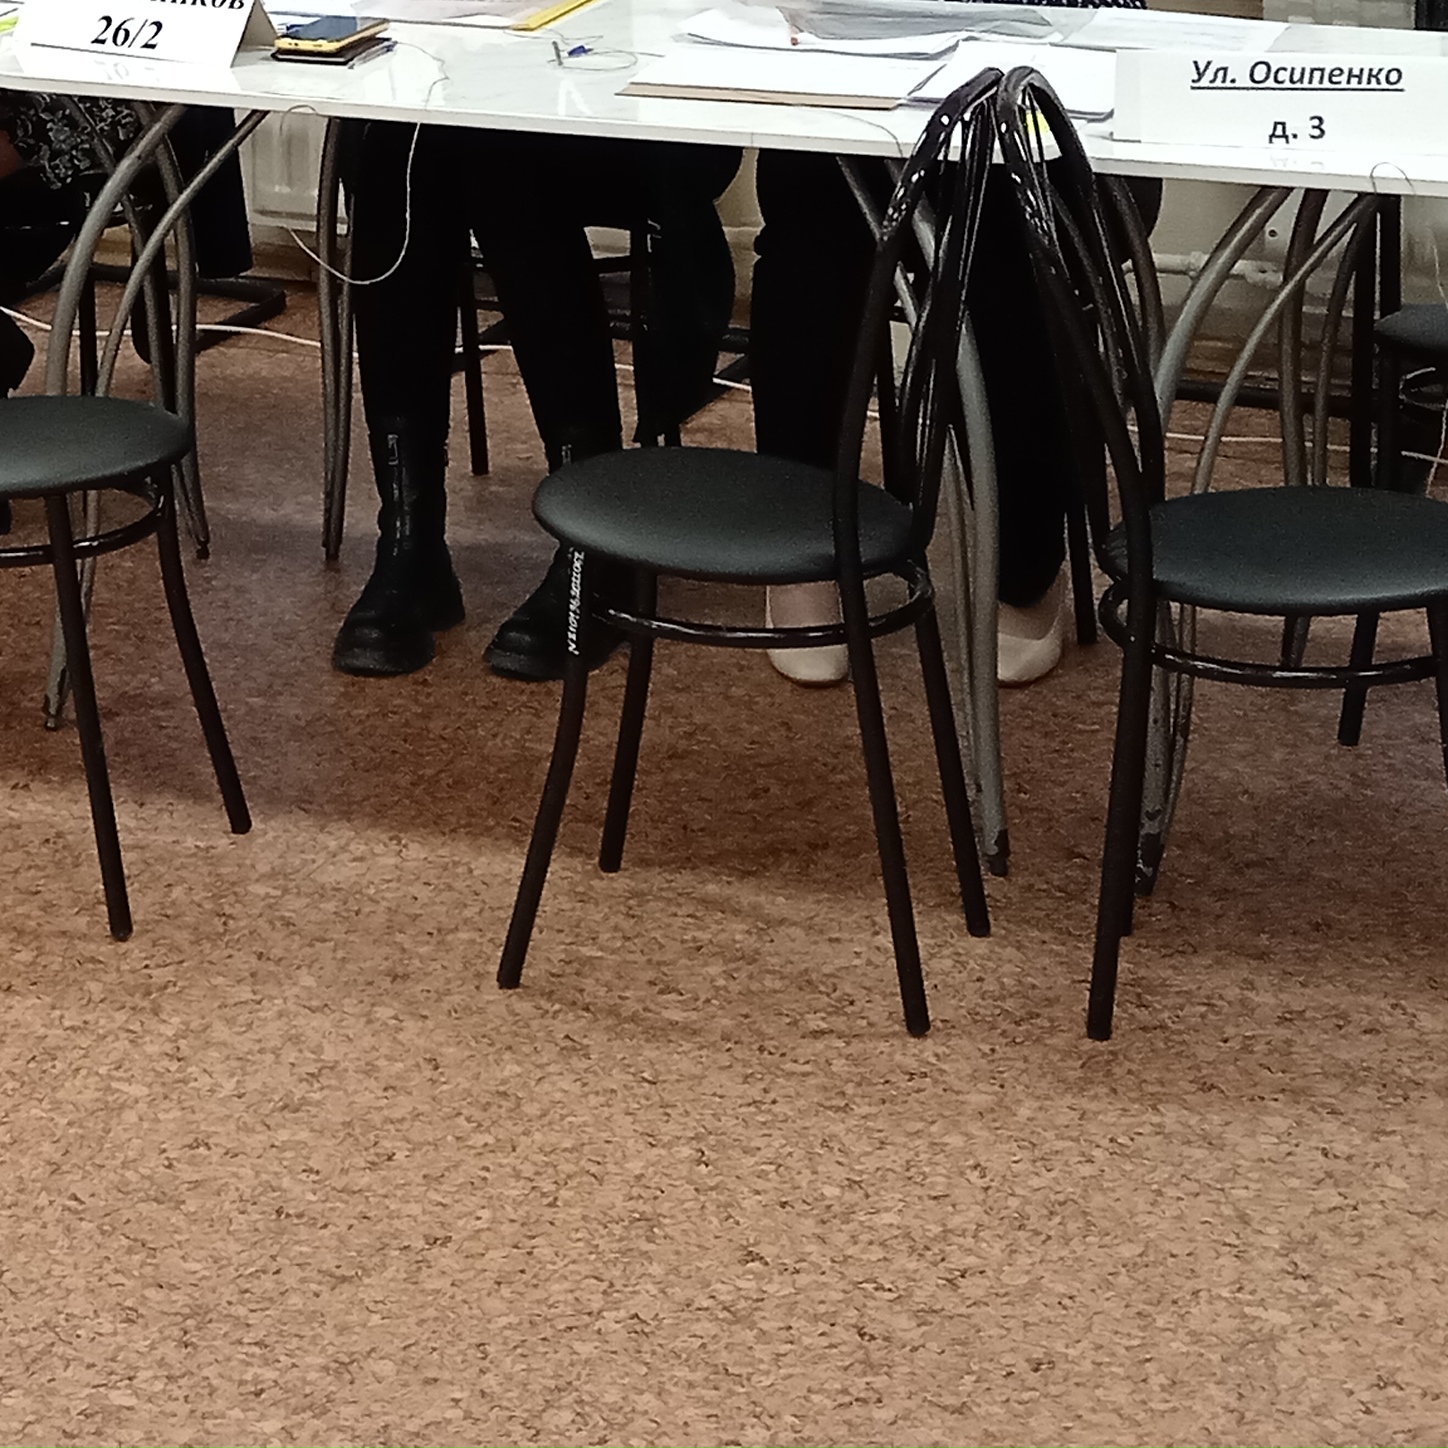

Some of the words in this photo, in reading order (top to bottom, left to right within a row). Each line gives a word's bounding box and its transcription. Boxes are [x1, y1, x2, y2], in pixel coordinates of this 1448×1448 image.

[90, 15, 164, 50] 26/2
[1190, 60, 1237, 85] Ул.
[1249, 60, 1404, 86] Осипенко
[1268, 120, 1299, 144] д.
[1308, 115, 1326, 140] 3
